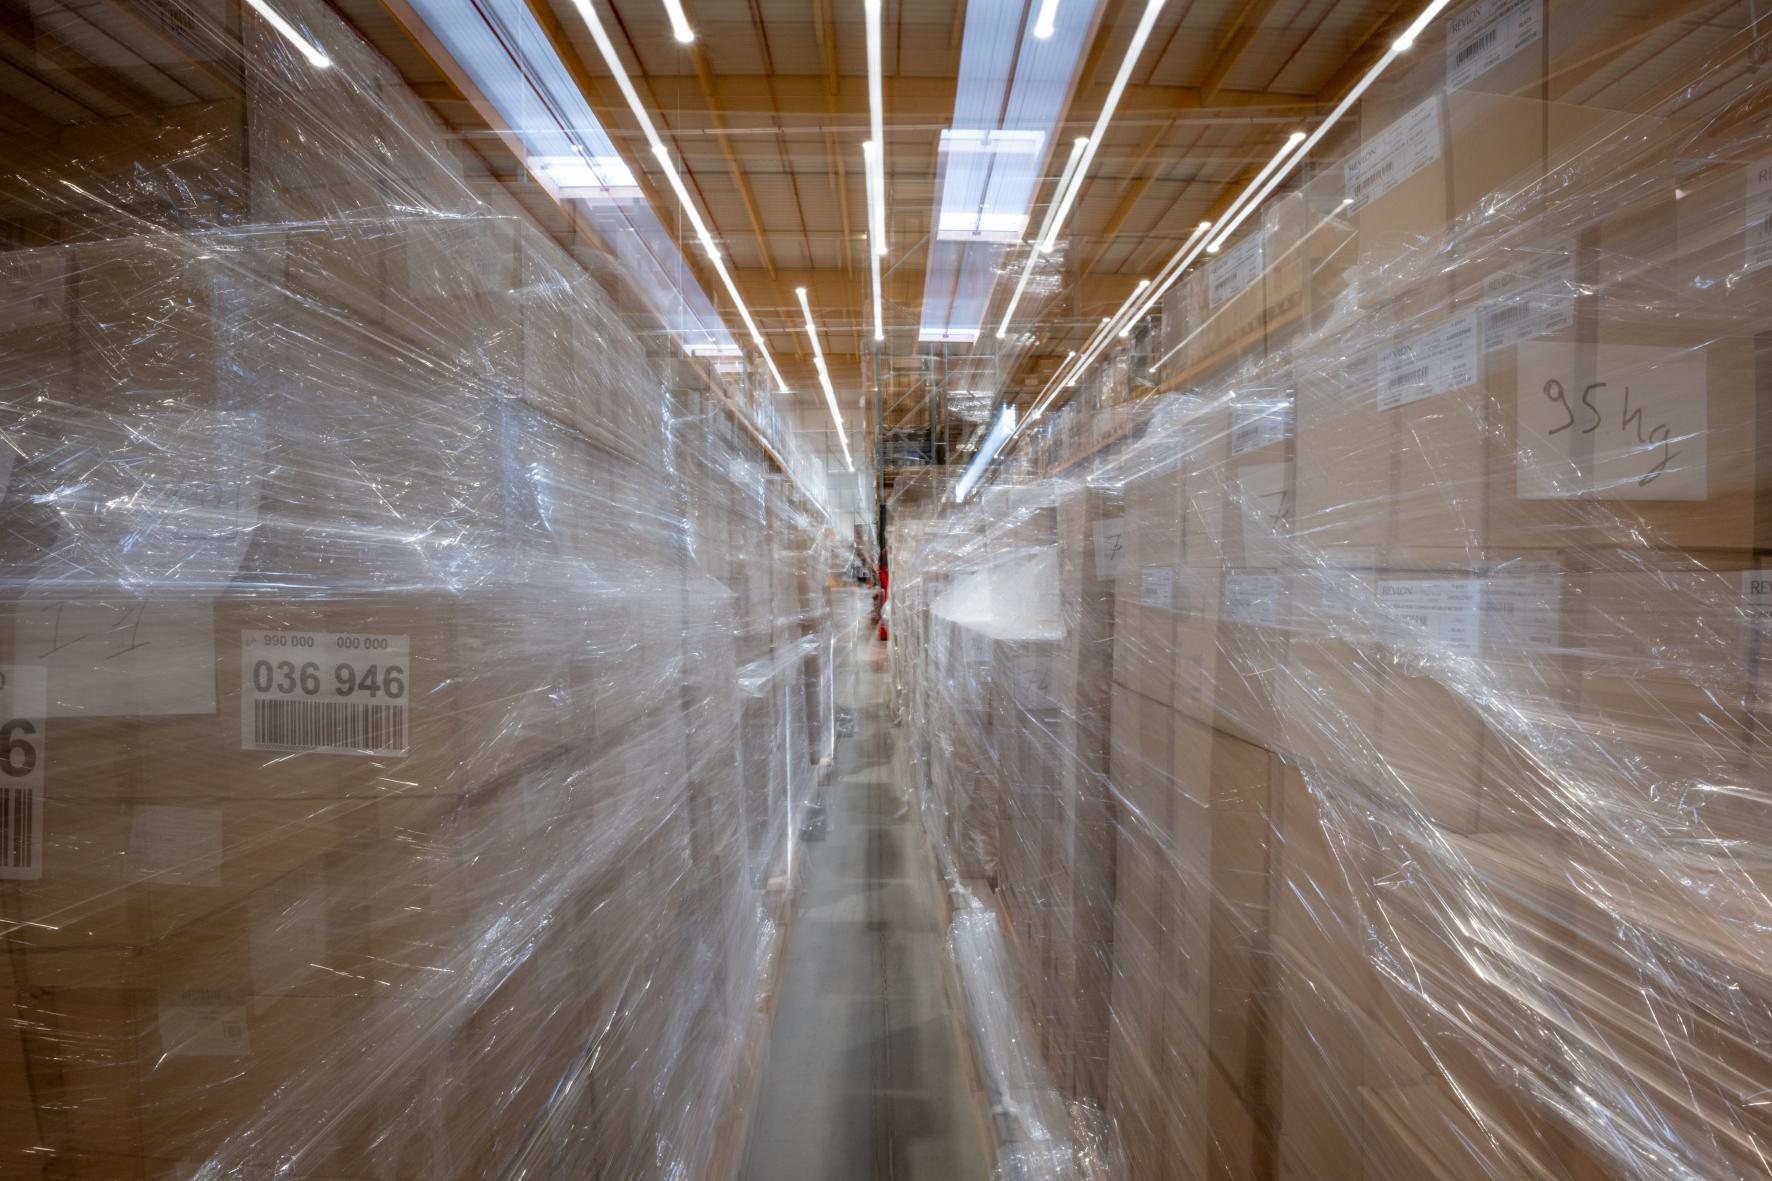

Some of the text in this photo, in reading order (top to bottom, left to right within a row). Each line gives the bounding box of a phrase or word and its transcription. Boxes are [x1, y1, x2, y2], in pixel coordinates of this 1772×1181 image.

[1450, 7, 1481, 33] REVLON
[1543, 379, 1606, 435] 95
[1751, 580, 1772, 594] RE
[264, 634, 287, 646] 990
[291, 635, 314, 648] 000
[336, 636, 360, 649] 000
[364, 638, 388, 650] 000
[253, 659, 405, 699] 036 946
